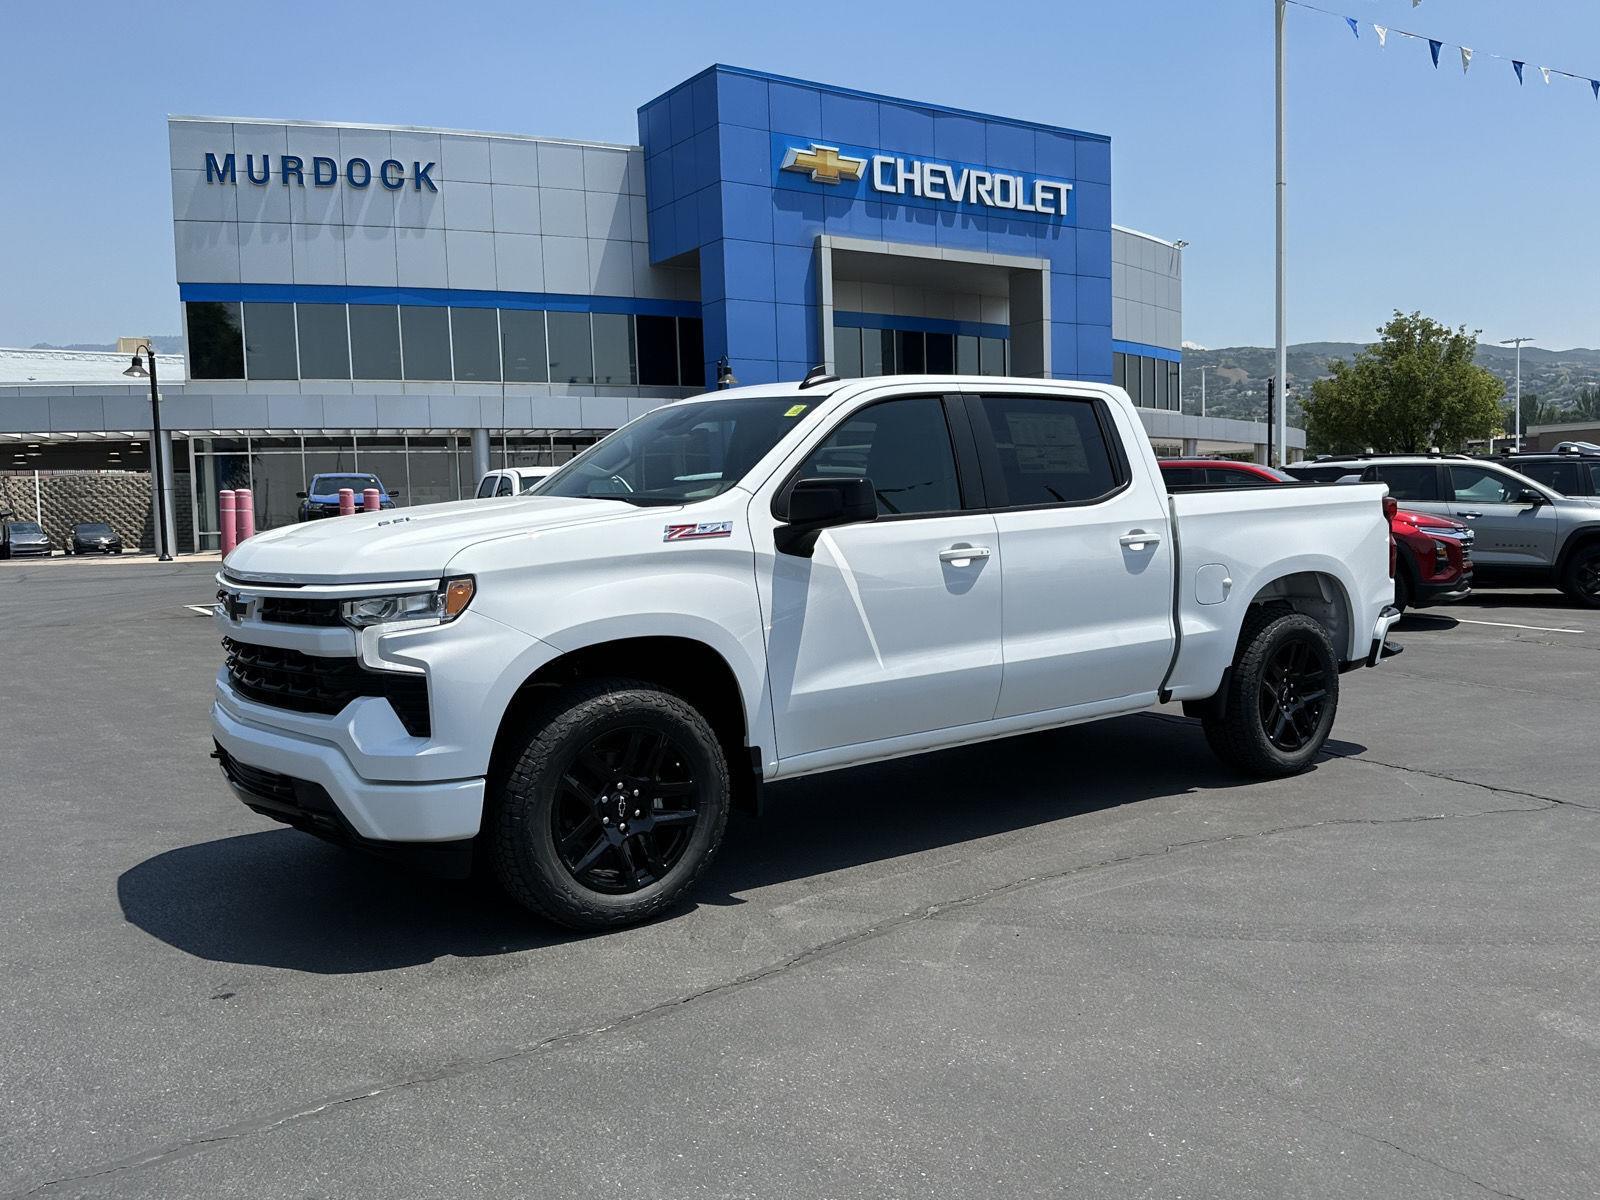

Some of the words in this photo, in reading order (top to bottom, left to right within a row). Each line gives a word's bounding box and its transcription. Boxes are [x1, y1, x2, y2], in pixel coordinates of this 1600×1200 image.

[205, 152, 438, 192] MURDOCK
[872, 155, 1073, 216] CHEVROLET
[663, 521, 733, 542] Z71
